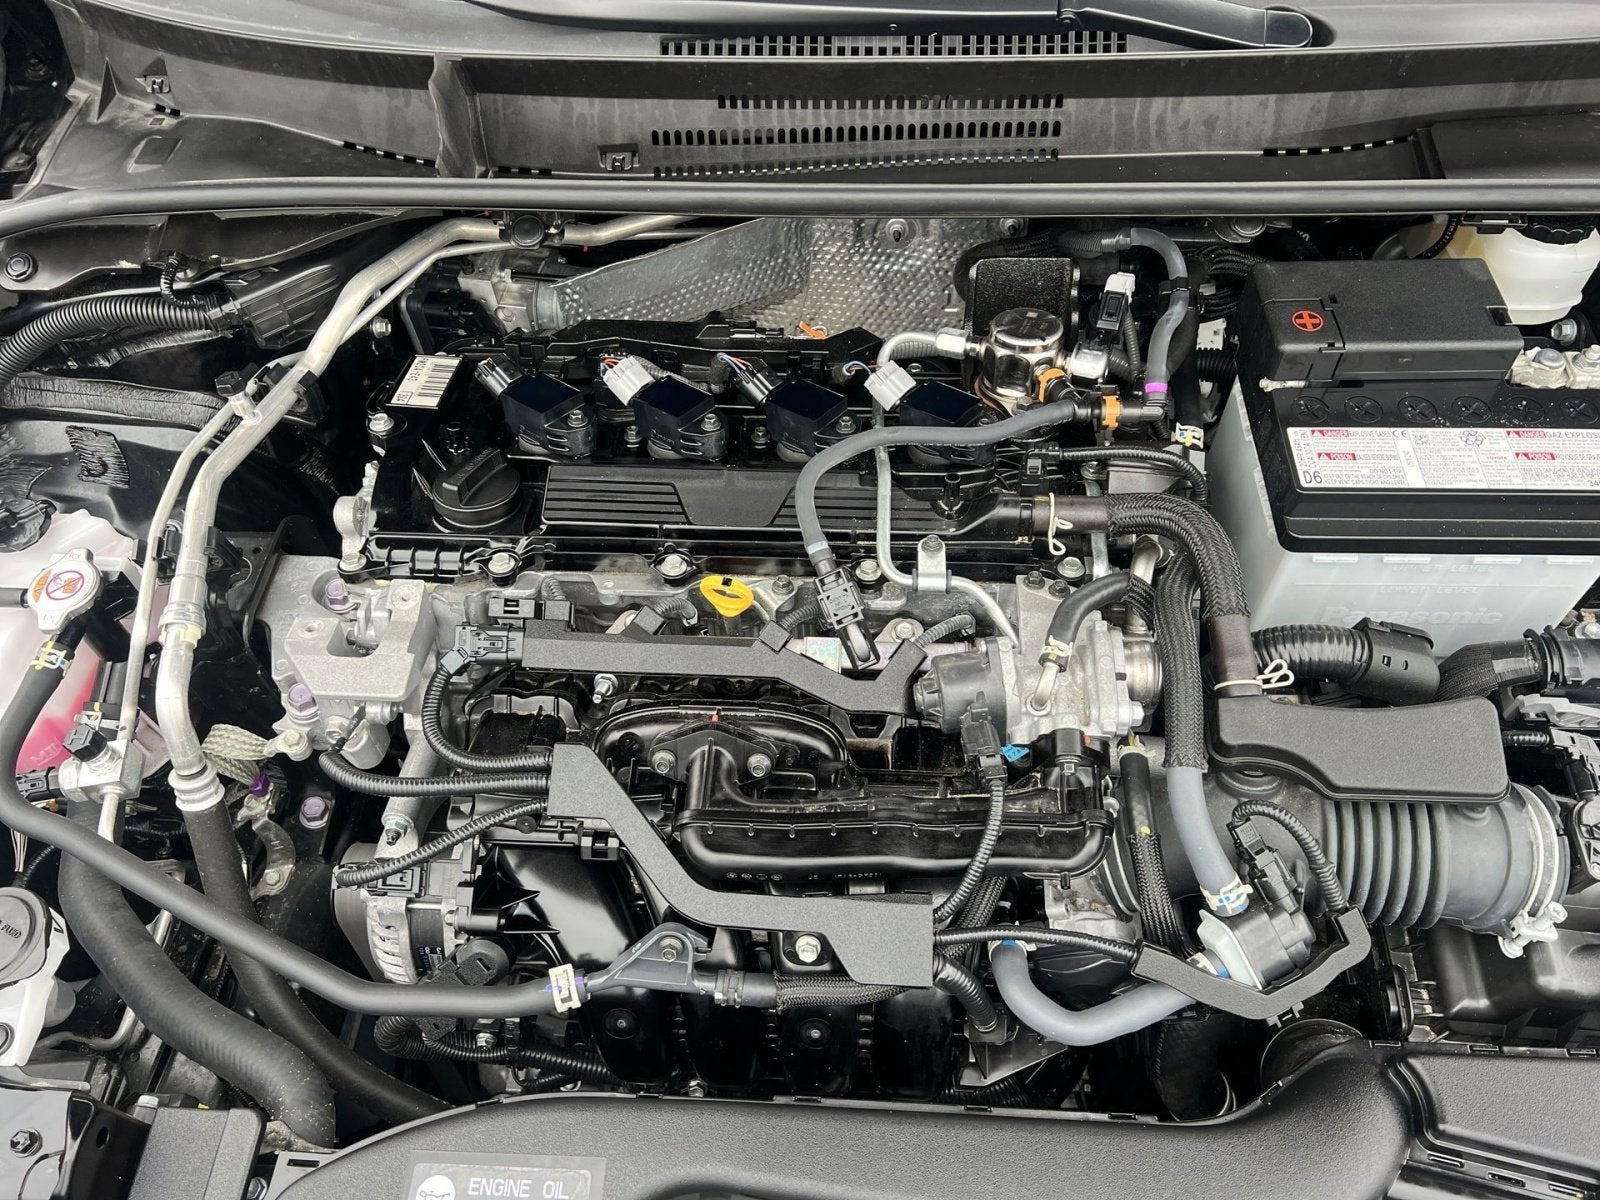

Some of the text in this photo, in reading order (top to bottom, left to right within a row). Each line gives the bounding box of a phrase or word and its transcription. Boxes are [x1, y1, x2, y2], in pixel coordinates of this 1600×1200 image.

[1303, 470, 1323, 484] D6
[1450, 564, 1496, 573] LEVEL
[1436, 586, 1481, 594] LEVEL
[1319, 606, 1505, 625] Panasonic
[467, 1177, 570, 1199] ENGINE OIL
